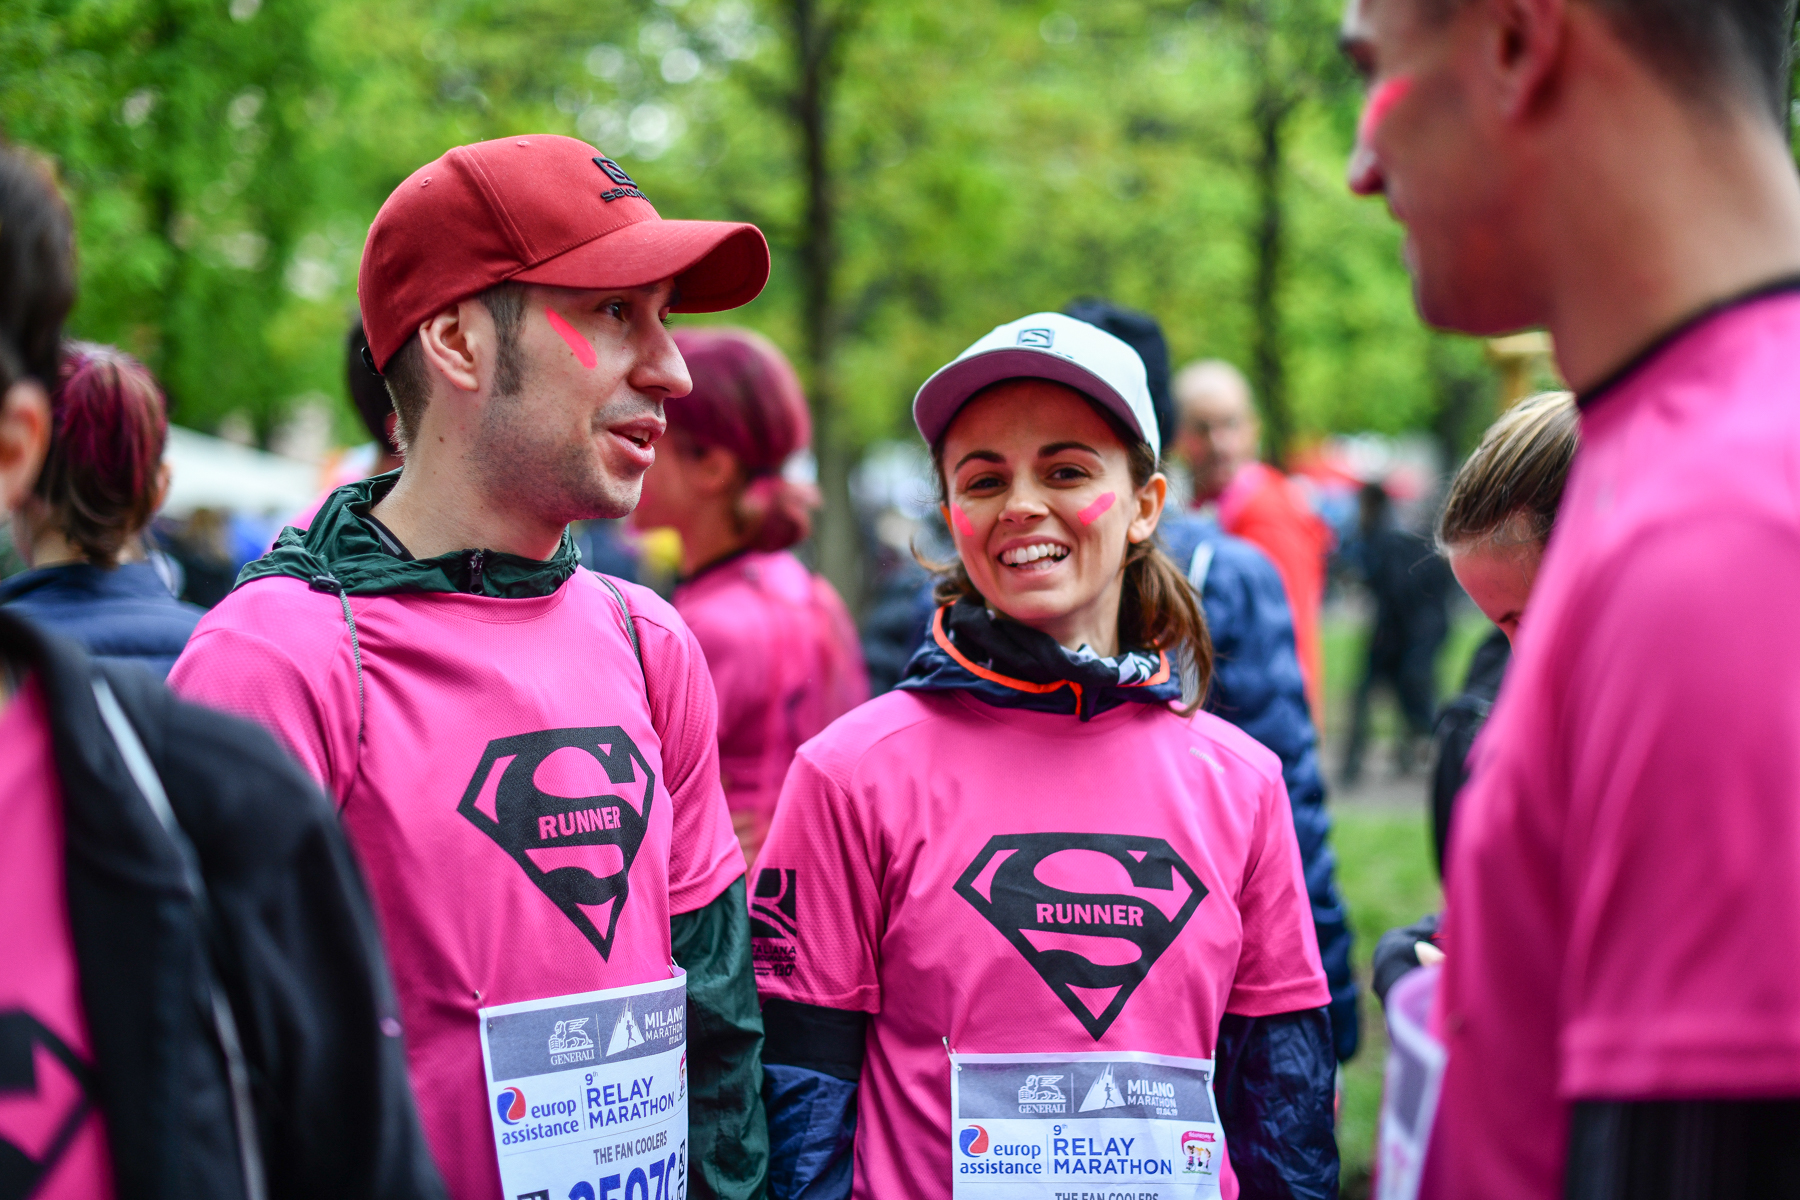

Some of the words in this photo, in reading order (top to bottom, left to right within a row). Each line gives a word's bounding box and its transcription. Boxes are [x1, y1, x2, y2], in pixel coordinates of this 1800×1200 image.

[538, 806, 622, 840] RUNNER
[1036, 903, 1144, 927] RUNNER
[644, 1004, 684, 1030] MILANO
[645, 1020, 683, 1042] MARATHON
[550, 1049, 595, 1066] GENERALI
[586, 1075, 654, 1109] RELAY
[1127, 1079, 1175, 1098] MILANO
[531, 1098, 577, 1119] europ
[588, 1091, 675, 1129] MARATHON
[1018, 1103, 1066, 1114] GENERALI
[1127, 1095, 1177, 1108] MARATHON
[502, 1119, 579, 1145] assistance
[593, 1145, 614, 1166] THE
[615, 1140, 634, 1161] FAN
[635, 1130, 668, 1156] COOLERS
[993, 1143, 1042, 1159] europ
[1053, 1137, 1136, 1156] RELAY
[959, 1159, 1043, 1175] assistance
[1053, 1159, 1173, 1175] MARATHON
